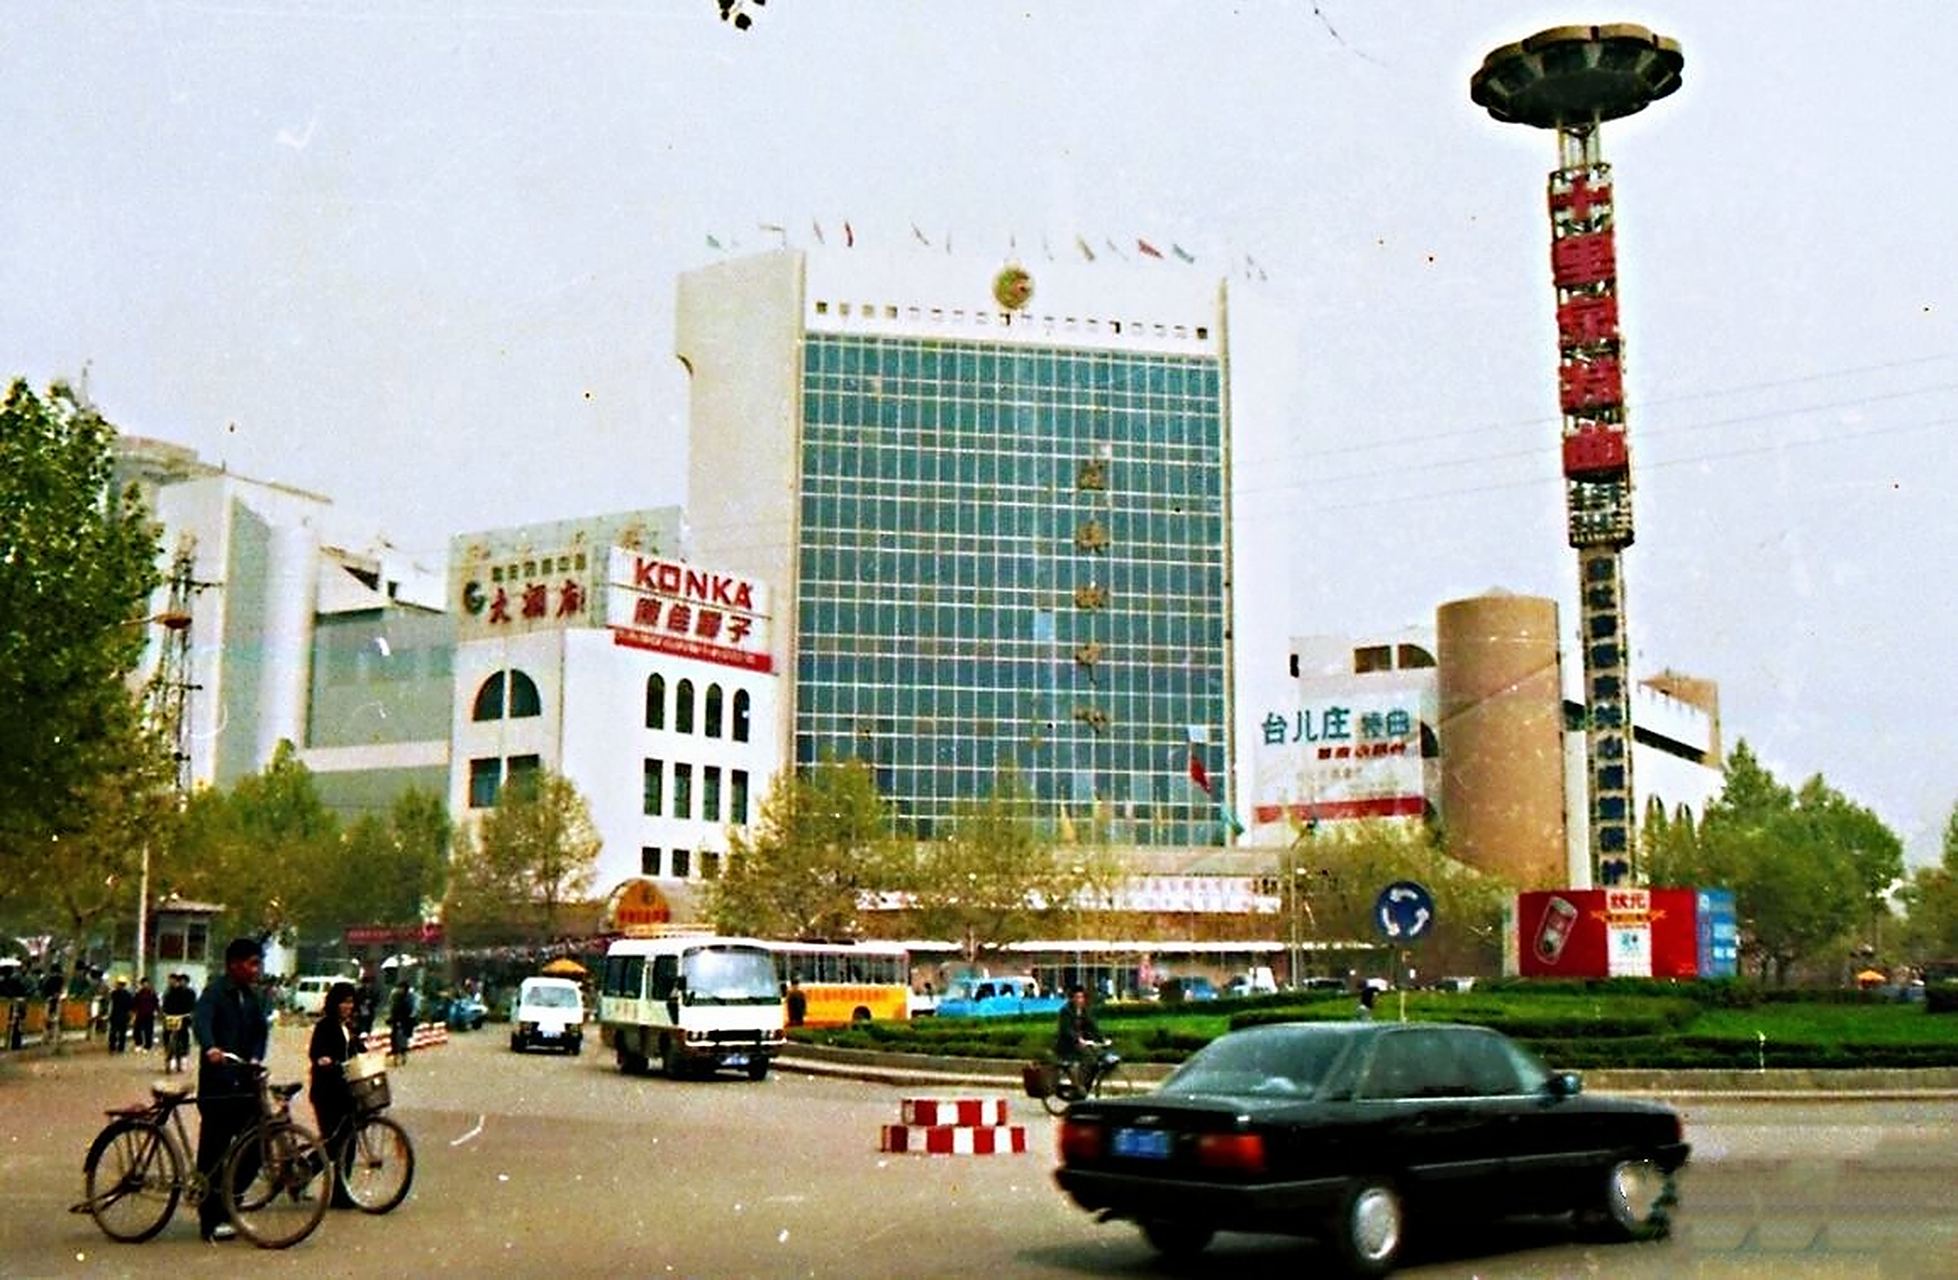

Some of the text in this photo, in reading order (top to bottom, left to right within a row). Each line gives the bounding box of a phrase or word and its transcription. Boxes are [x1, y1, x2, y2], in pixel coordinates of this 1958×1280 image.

[634, 557, 753, 610] KONKA
[1262, 706, 1351, 745] 台儿庄
